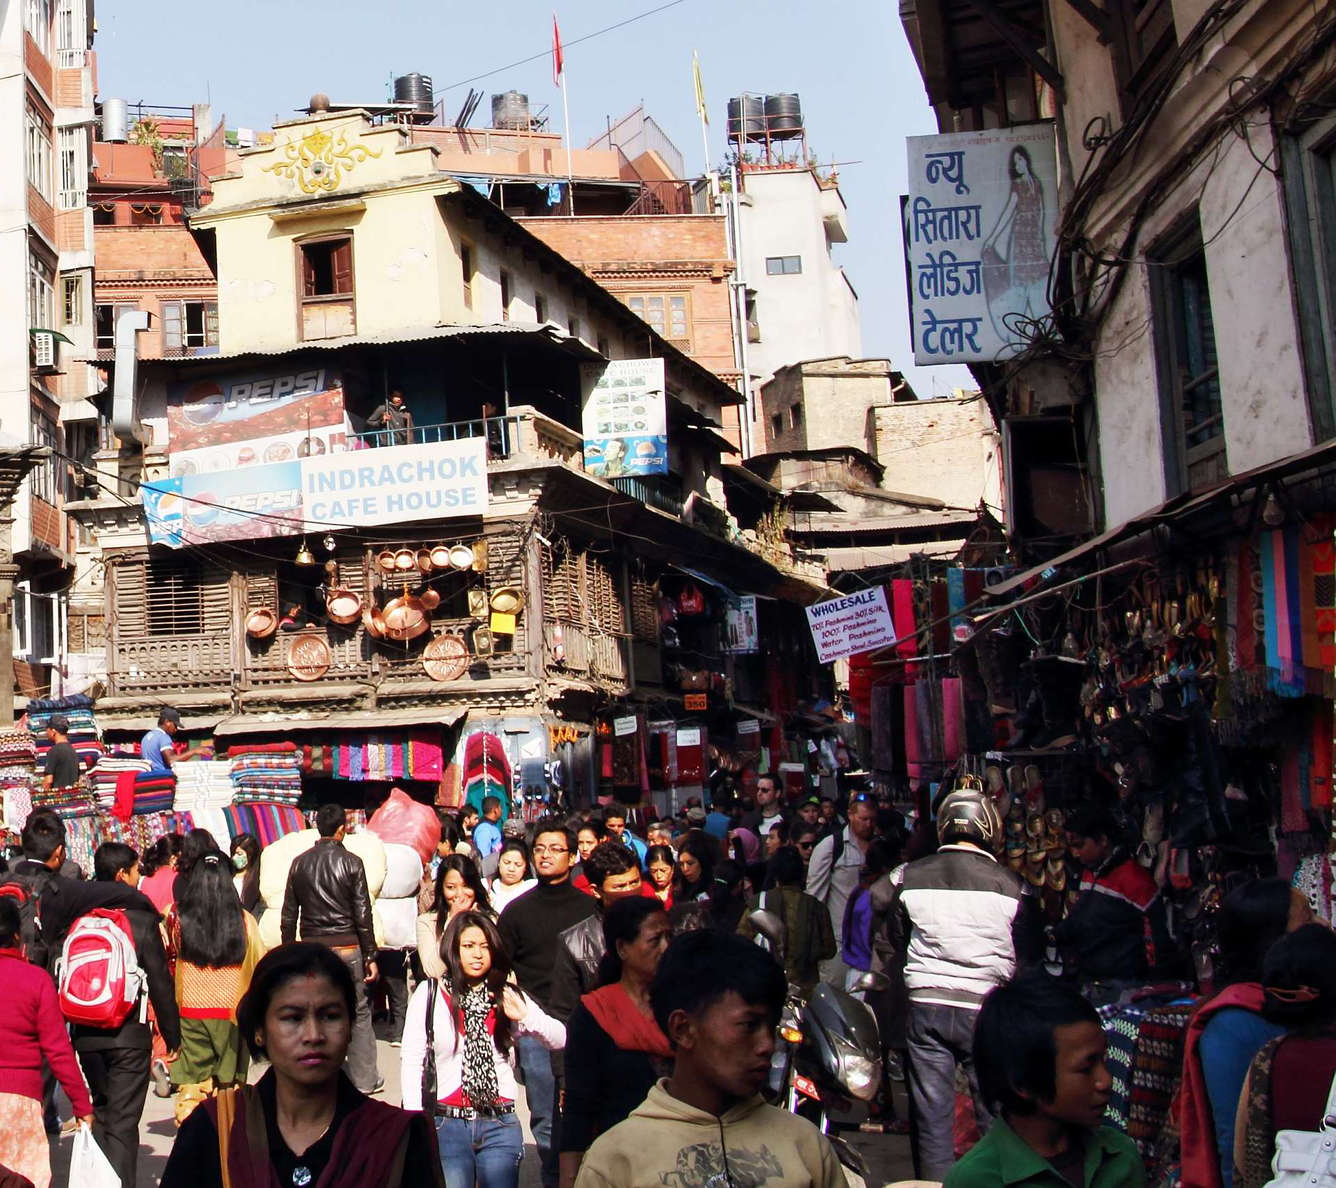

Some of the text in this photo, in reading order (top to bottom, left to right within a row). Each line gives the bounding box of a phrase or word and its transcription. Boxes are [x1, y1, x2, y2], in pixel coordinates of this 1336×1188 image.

[924, 150, 970, 195] न्यू
[913, 196, 982, 244] सितारा
[917, 250, 983, 300] लेडिज
[921, 309, 983, 356] टेलर
[228, 368, 327, 410] PEPSI
[307, 454, 480, 494] INDRACHOK
[222, 489, 301, 515] PEPSI
[311, 486, 477, 521] CAFE HOUSE
[810, 590, 876, 618] WHOLESALE
